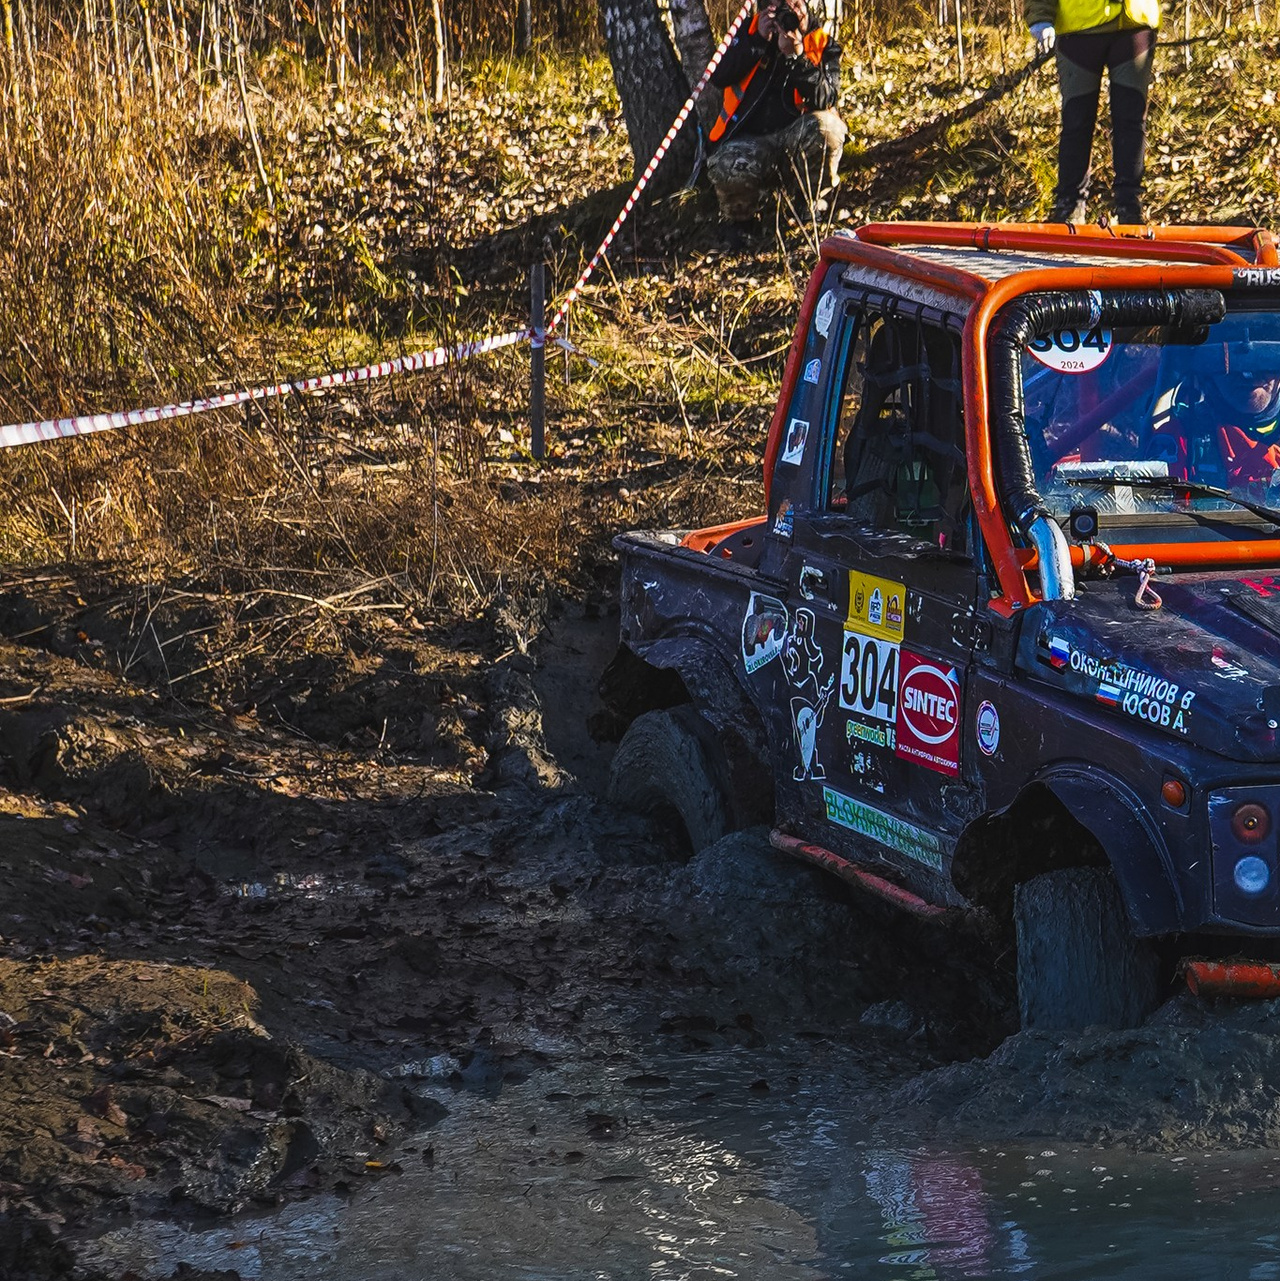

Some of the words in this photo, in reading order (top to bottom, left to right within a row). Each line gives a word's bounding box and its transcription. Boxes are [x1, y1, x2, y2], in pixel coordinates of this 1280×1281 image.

[1029, 326, 1109, 353] 304
[1060, 361, 1085, 369] 2024
[841, 636, 896, 719] 304
[904, 686, 955, 724] SINTEC
[1122, 691, 1170, 726] ЮСОВ
